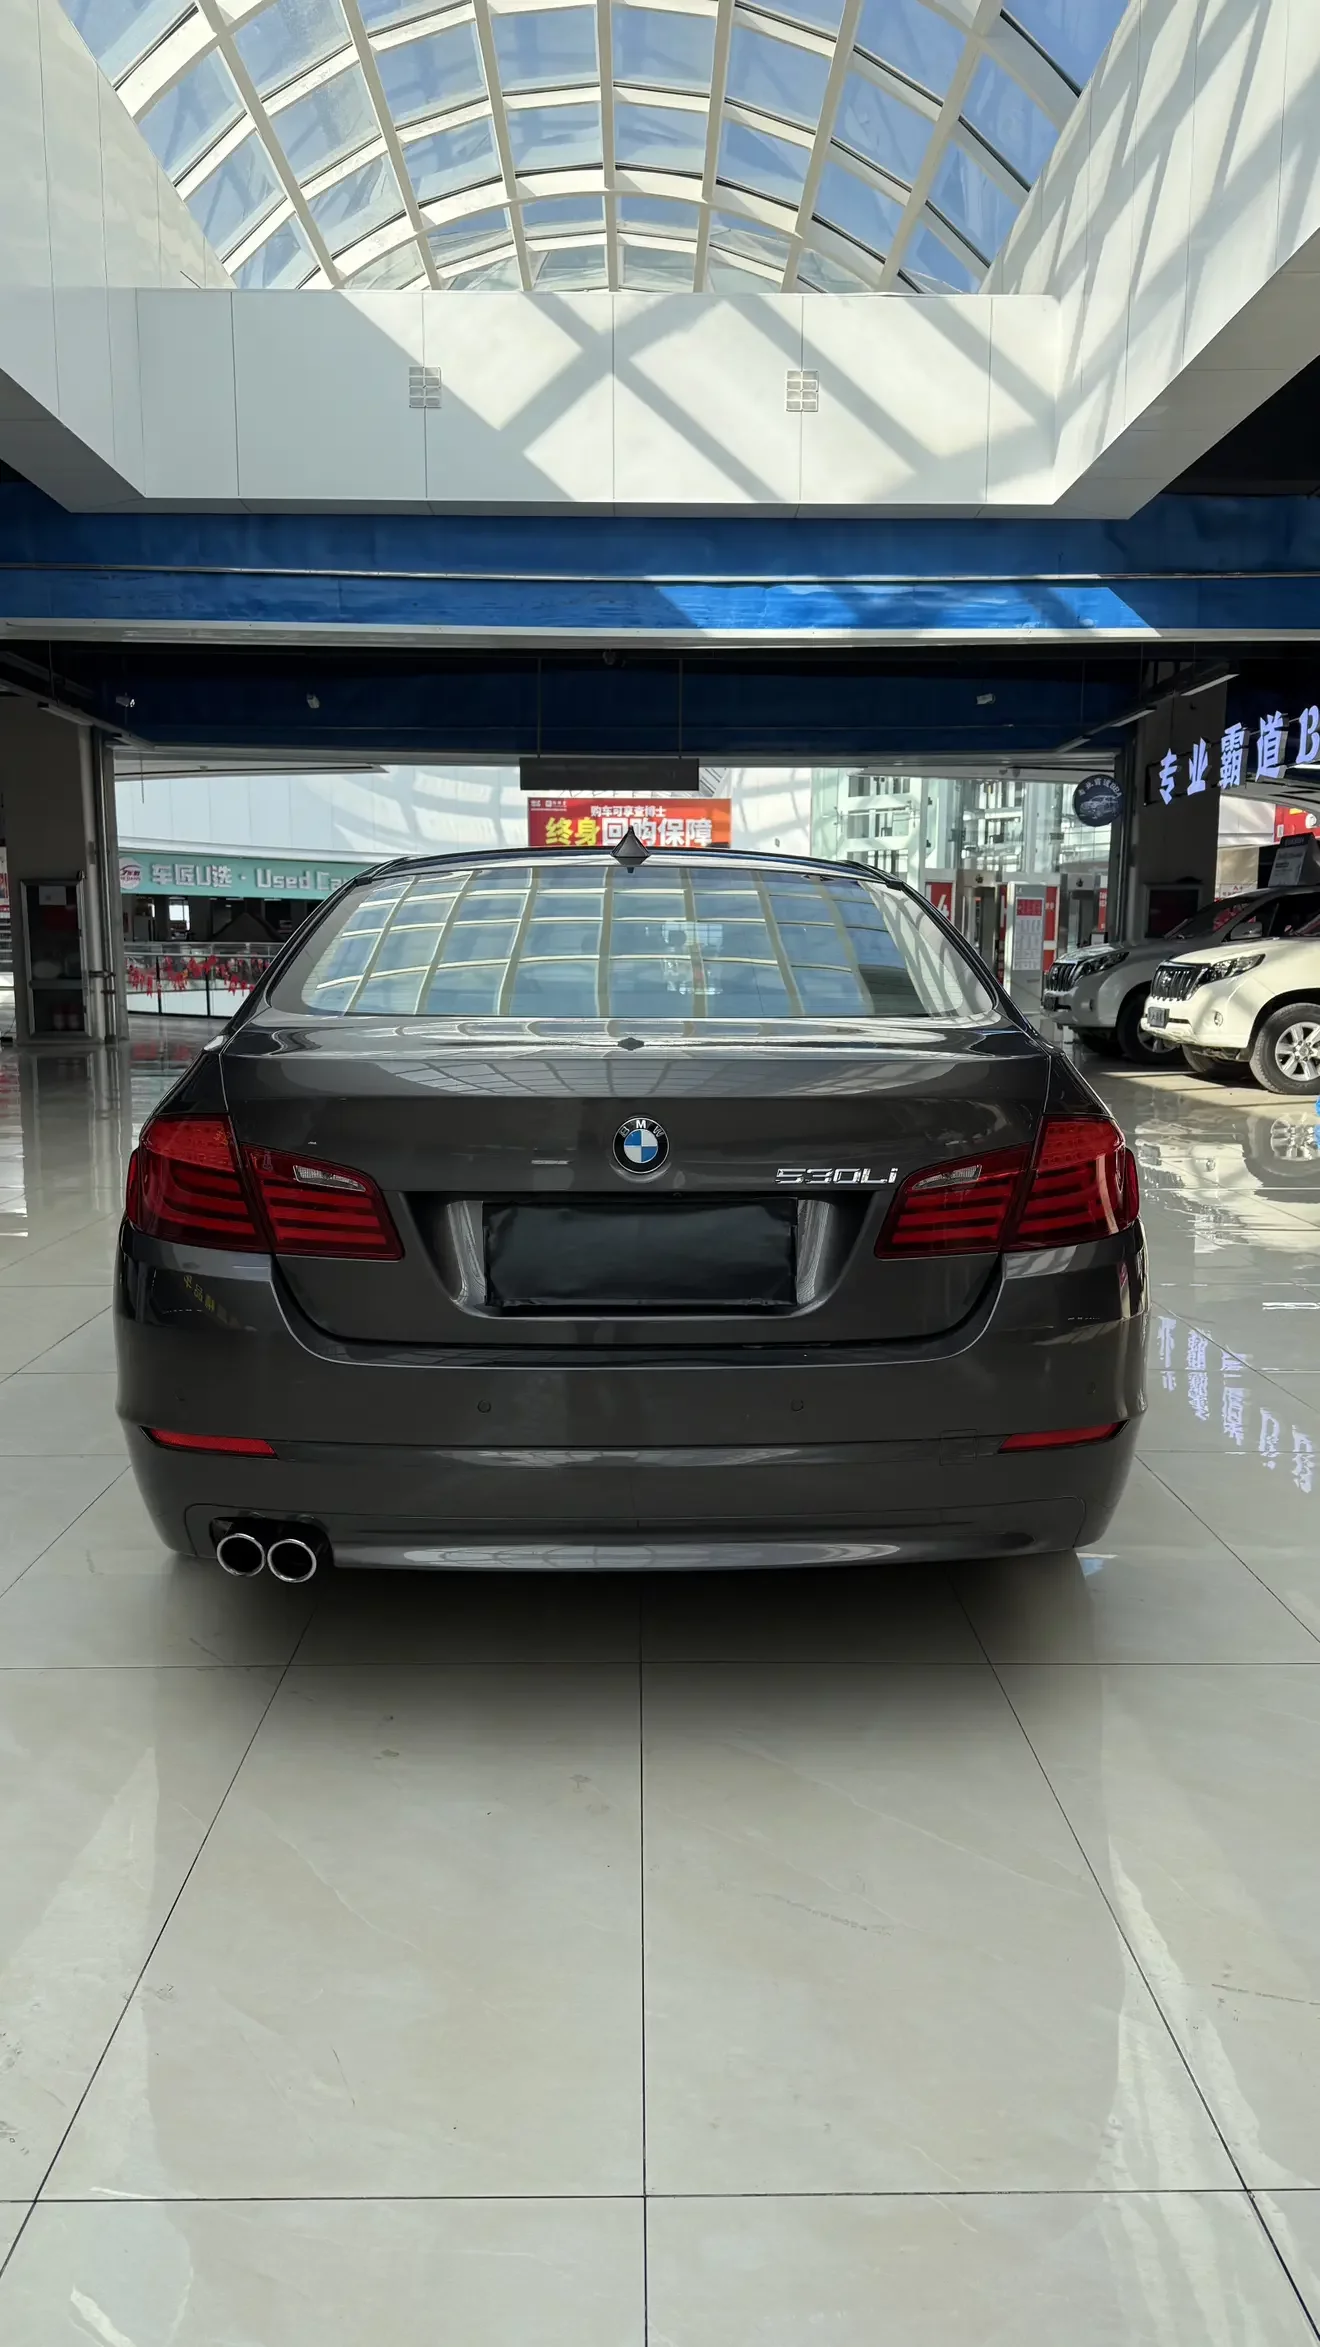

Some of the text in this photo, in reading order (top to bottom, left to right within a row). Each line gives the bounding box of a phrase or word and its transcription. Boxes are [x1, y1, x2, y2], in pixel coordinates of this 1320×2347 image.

[590, 805, 667, 818] 购车可享查博士
[545, 817, 713, 847] 终身回购保障
[255, 868, 311, 890] Used
[618, 1119, 666, 1138] BMW
[774, 1167, 899, 1184] 530Li
